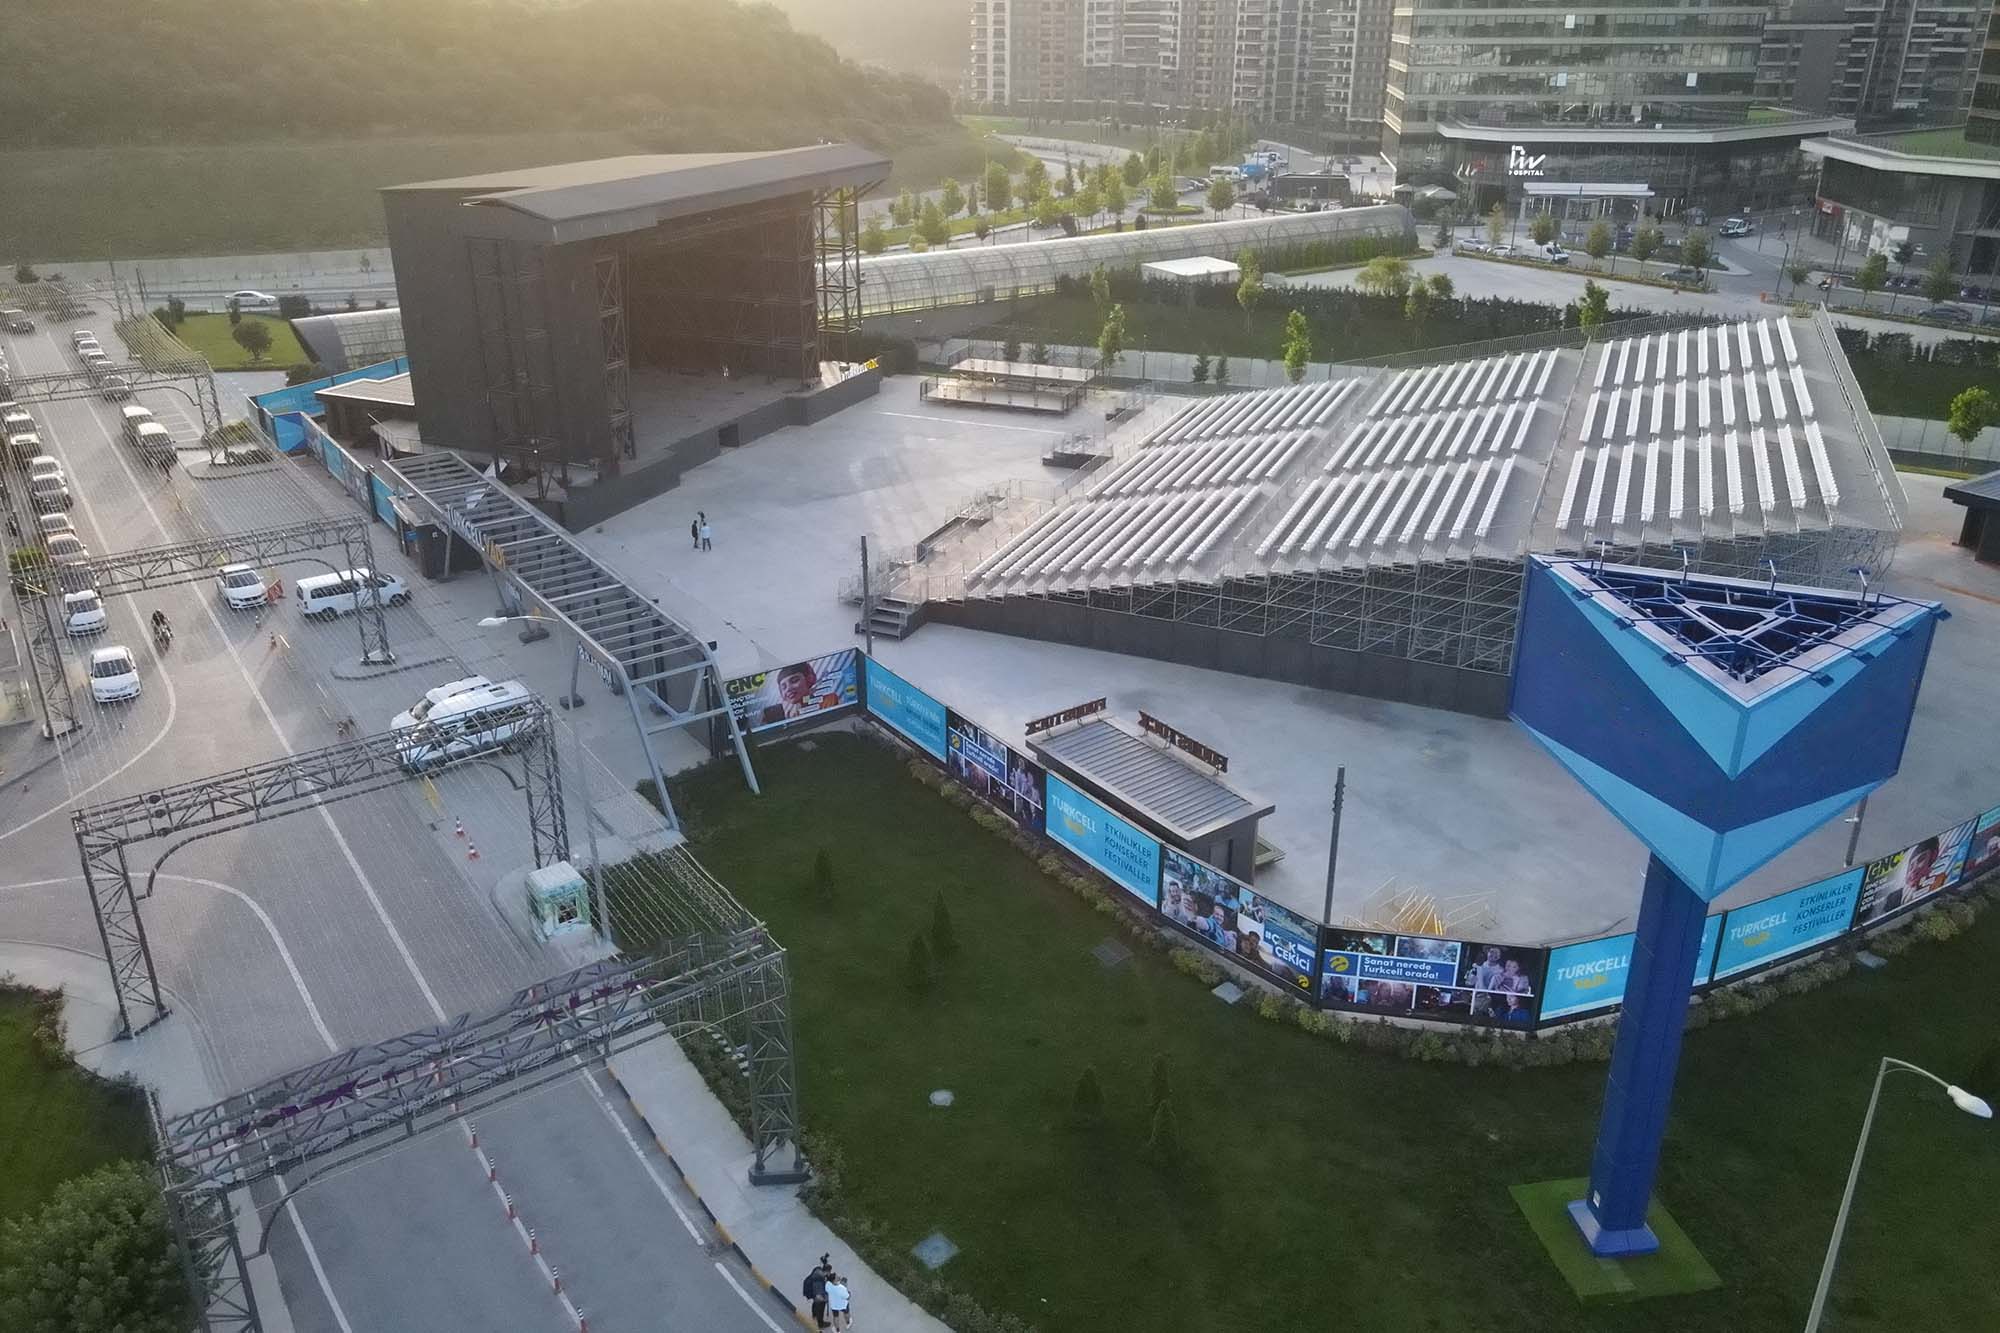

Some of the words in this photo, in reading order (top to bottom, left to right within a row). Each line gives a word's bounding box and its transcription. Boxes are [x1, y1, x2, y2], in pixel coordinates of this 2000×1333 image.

[1051, 794, 1097, 834] TURKCELL
[1104, 837, 1149, 870] KONSERLER
[1796, 896, 1847, 921] KONSERLER
[1730, 911, 1787, 940] TURKCELL
[1364, 957, 1394, 967] Sanat
[1396, 961, 1431, 971] nerede
[1364, 964, 1403, 976] Turkcell
[1405, 970, 1439, 980] orada!
[1557, 954, 1630, 981] TURKCELL
